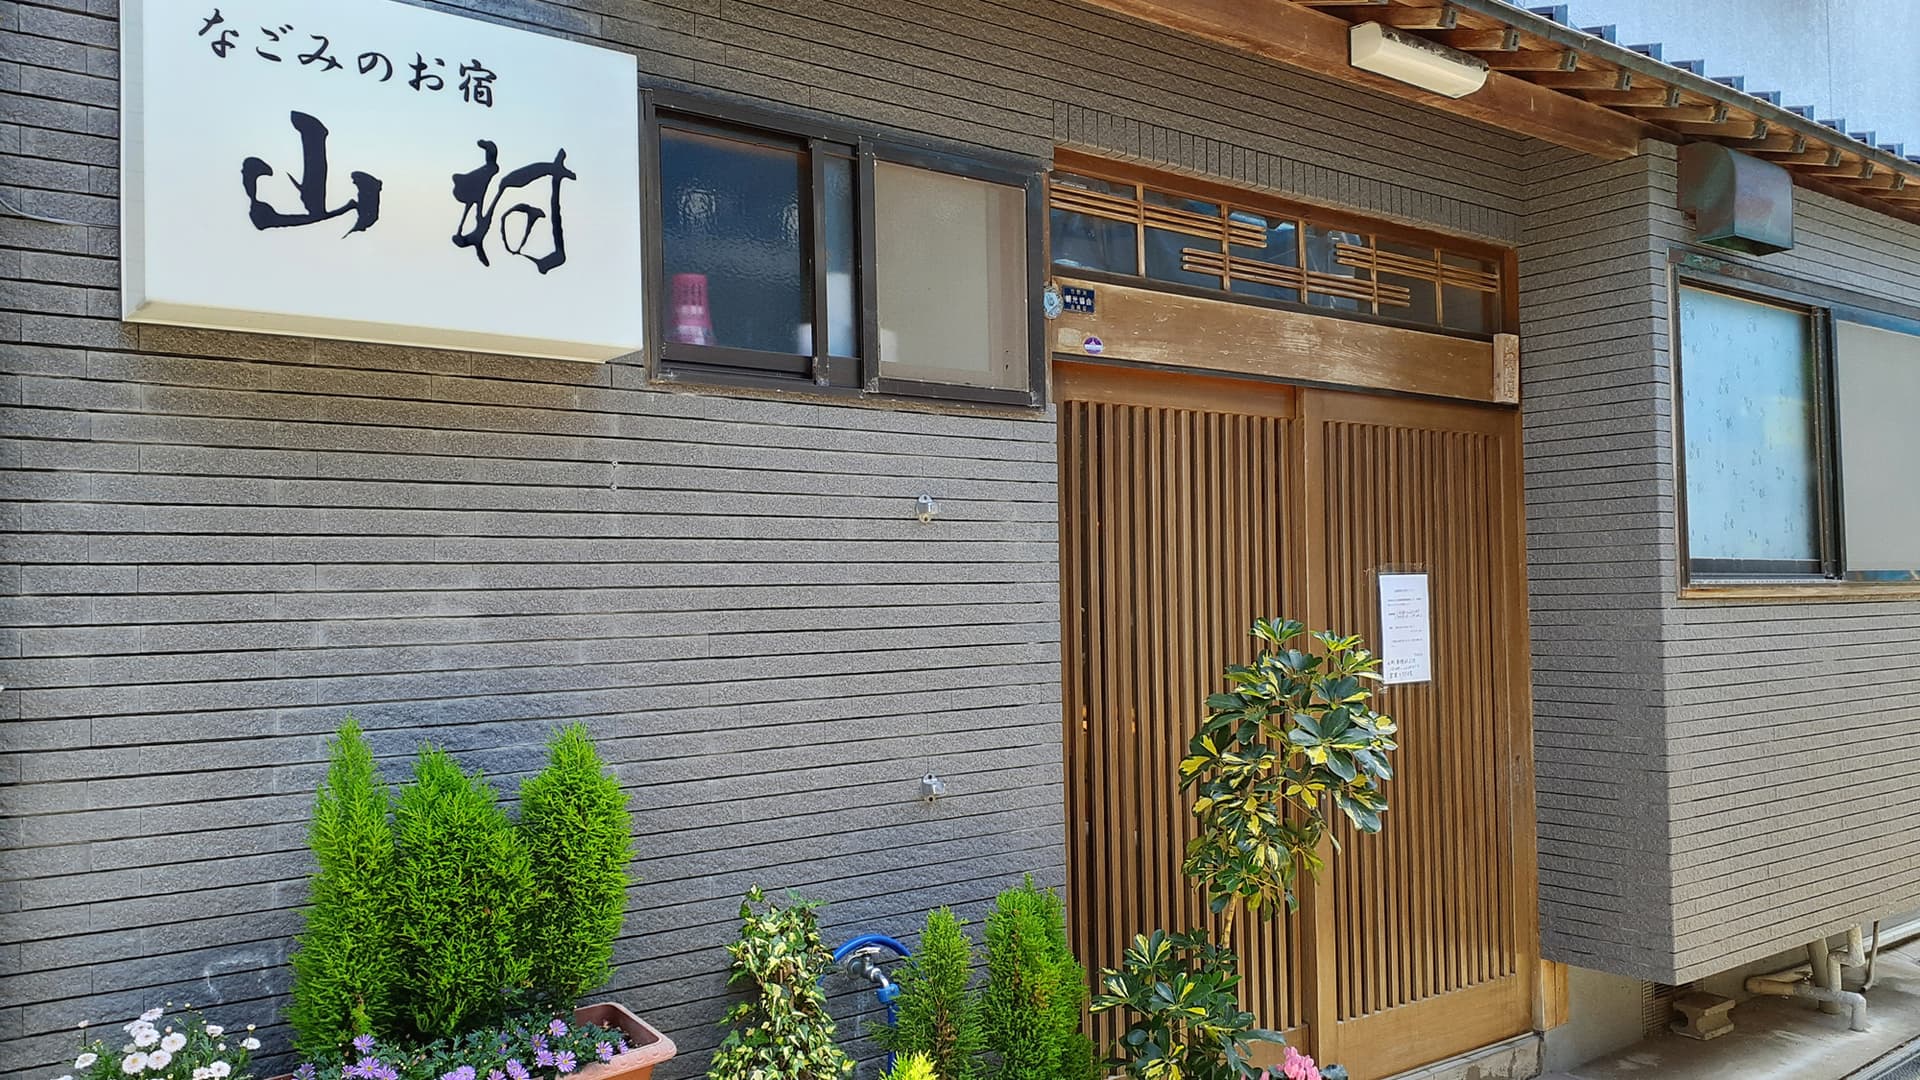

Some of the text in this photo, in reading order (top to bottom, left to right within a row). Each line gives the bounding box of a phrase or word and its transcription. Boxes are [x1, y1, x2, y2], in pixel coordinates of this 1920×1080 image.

[199, 9, 497, 107] なごみのお宿
[241, 111, 576, 275] 山村
